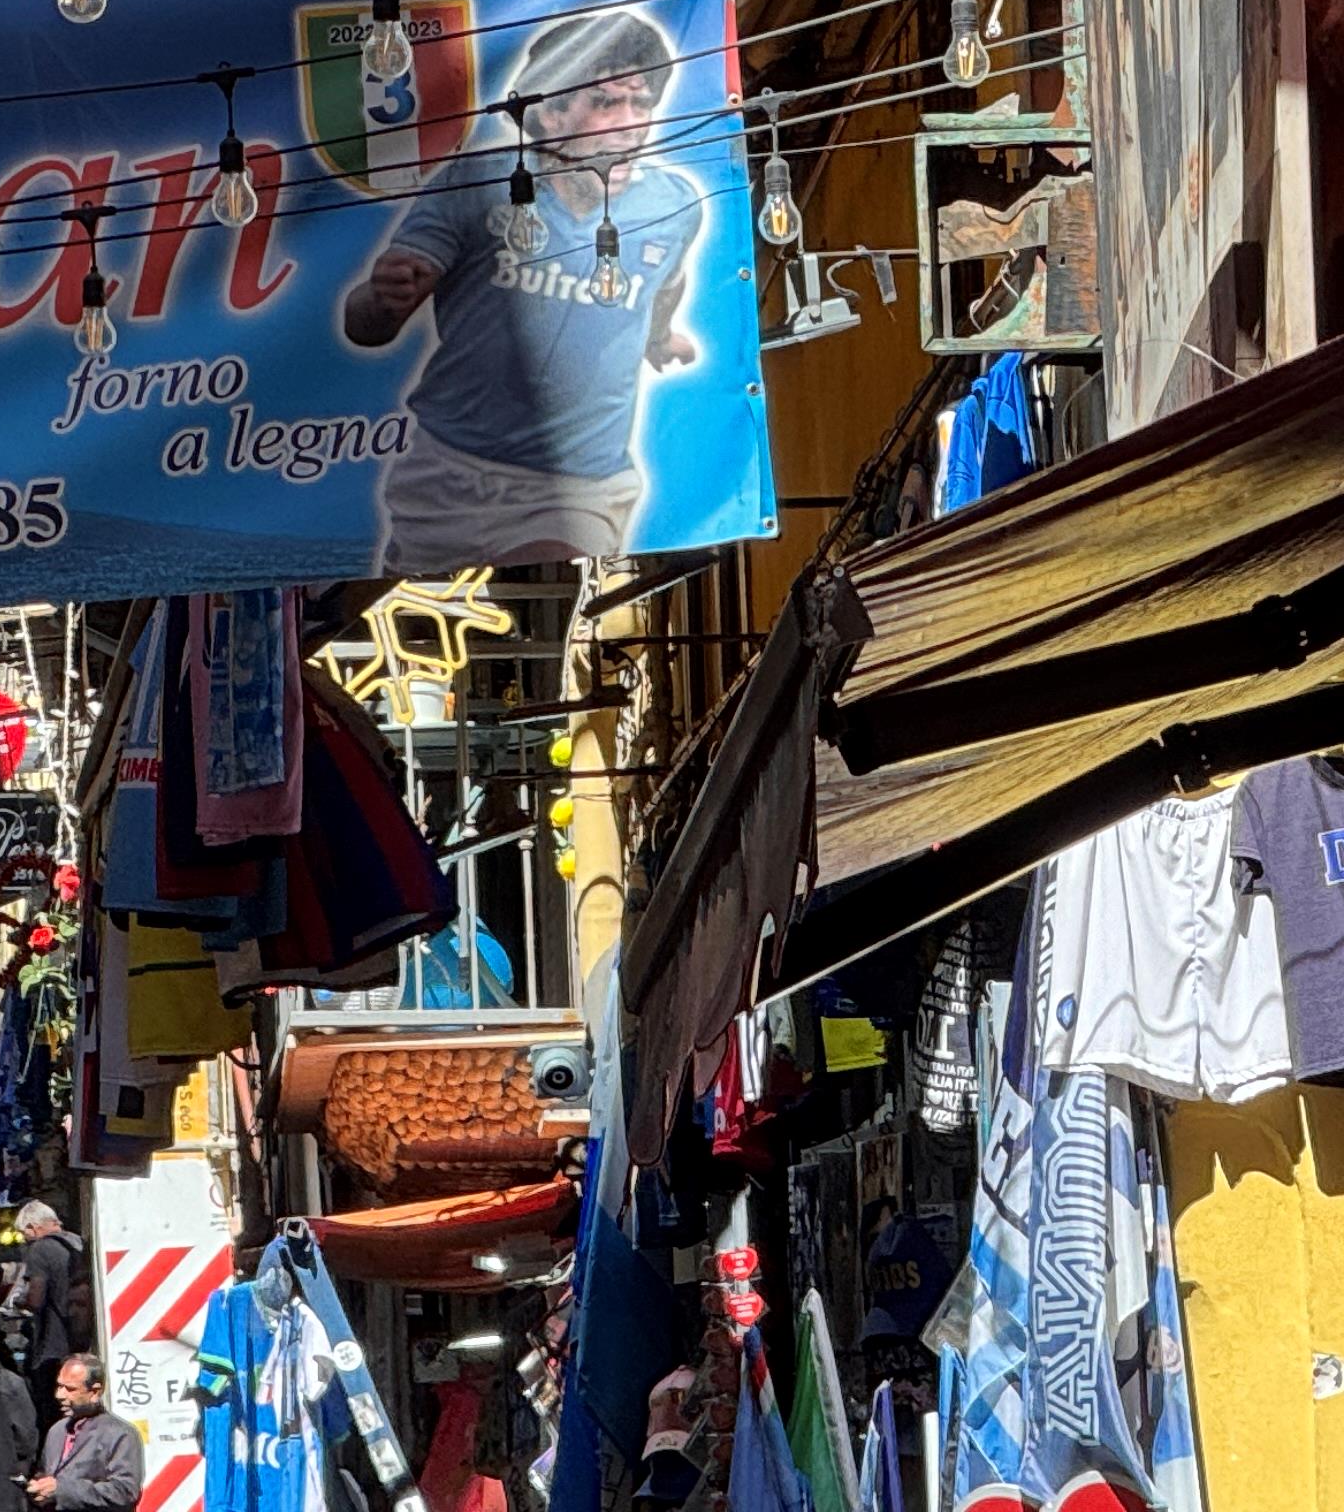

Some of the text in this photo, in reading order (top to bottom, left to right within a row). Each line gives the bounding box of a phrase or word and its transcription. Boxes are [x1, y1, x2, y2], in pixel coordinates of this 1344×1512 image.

[365, 68, 416, 125] 3
[55, 355, 248, 433] forno
[165, 407, 409, 481] a legna
